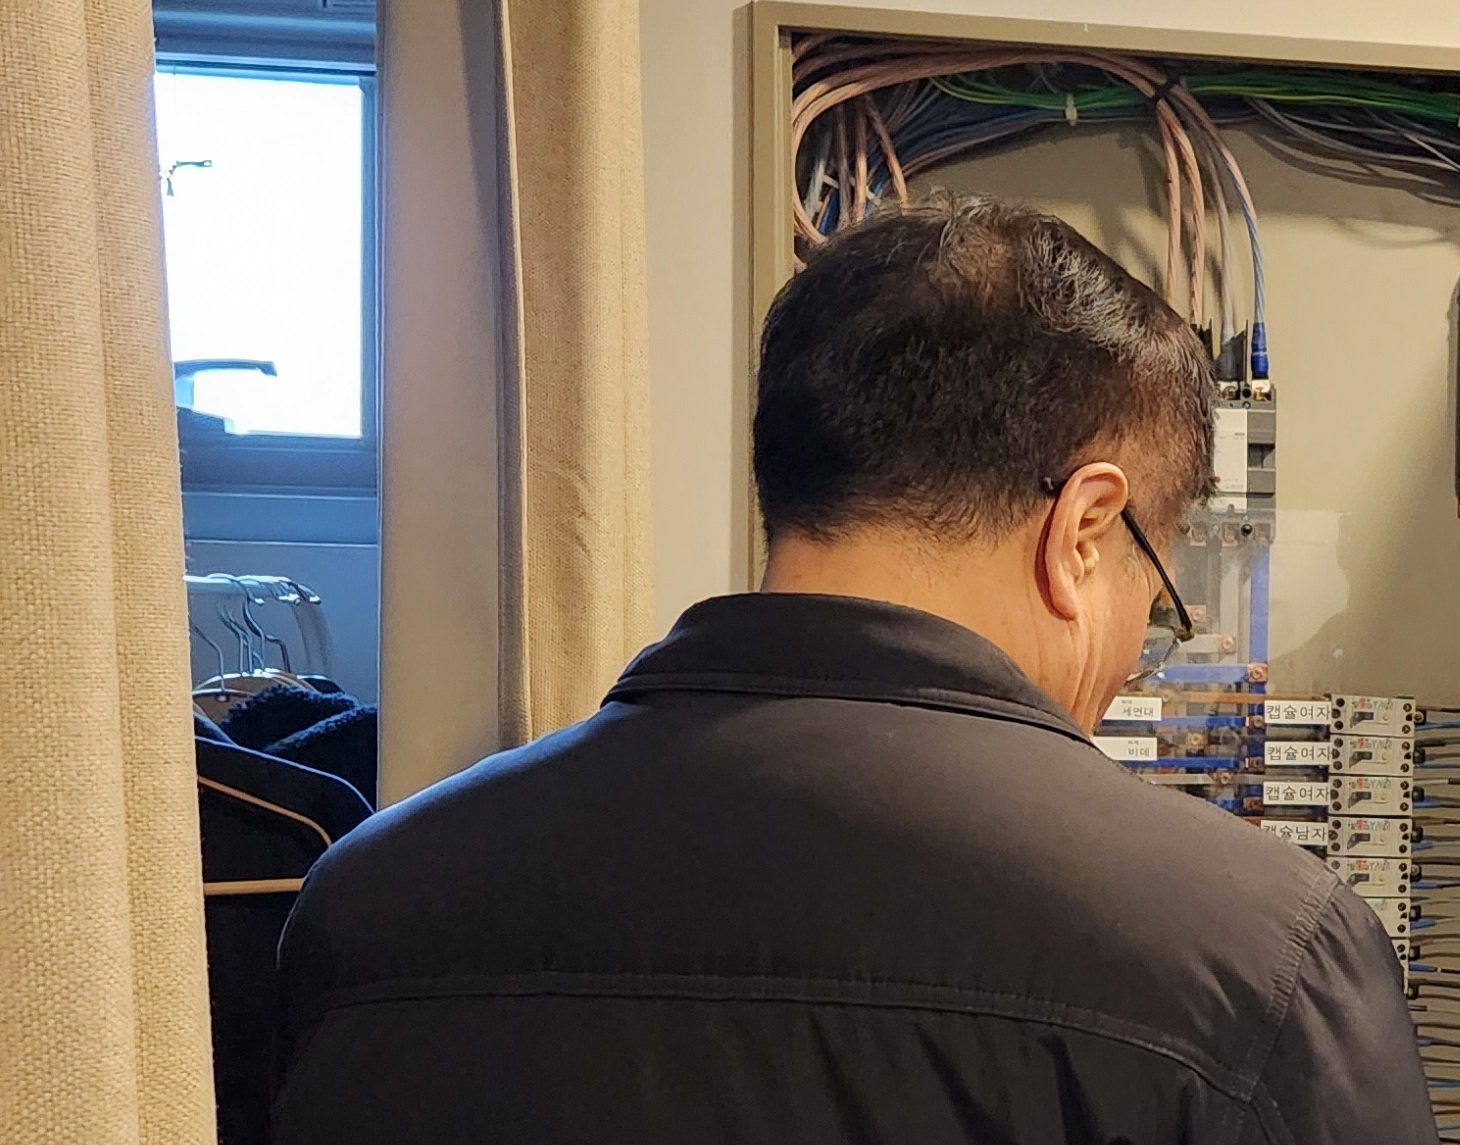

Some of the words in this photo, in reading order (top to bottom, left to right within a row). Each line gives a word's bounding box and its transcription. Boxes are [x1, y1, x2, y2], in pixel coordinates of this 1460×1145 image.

[1266, 703, 1330, 720] 캡슐여자
[1267, 745, 1330, 761] 캡슐여자
[1265, 785, 1329, 802] 캡슐여자
